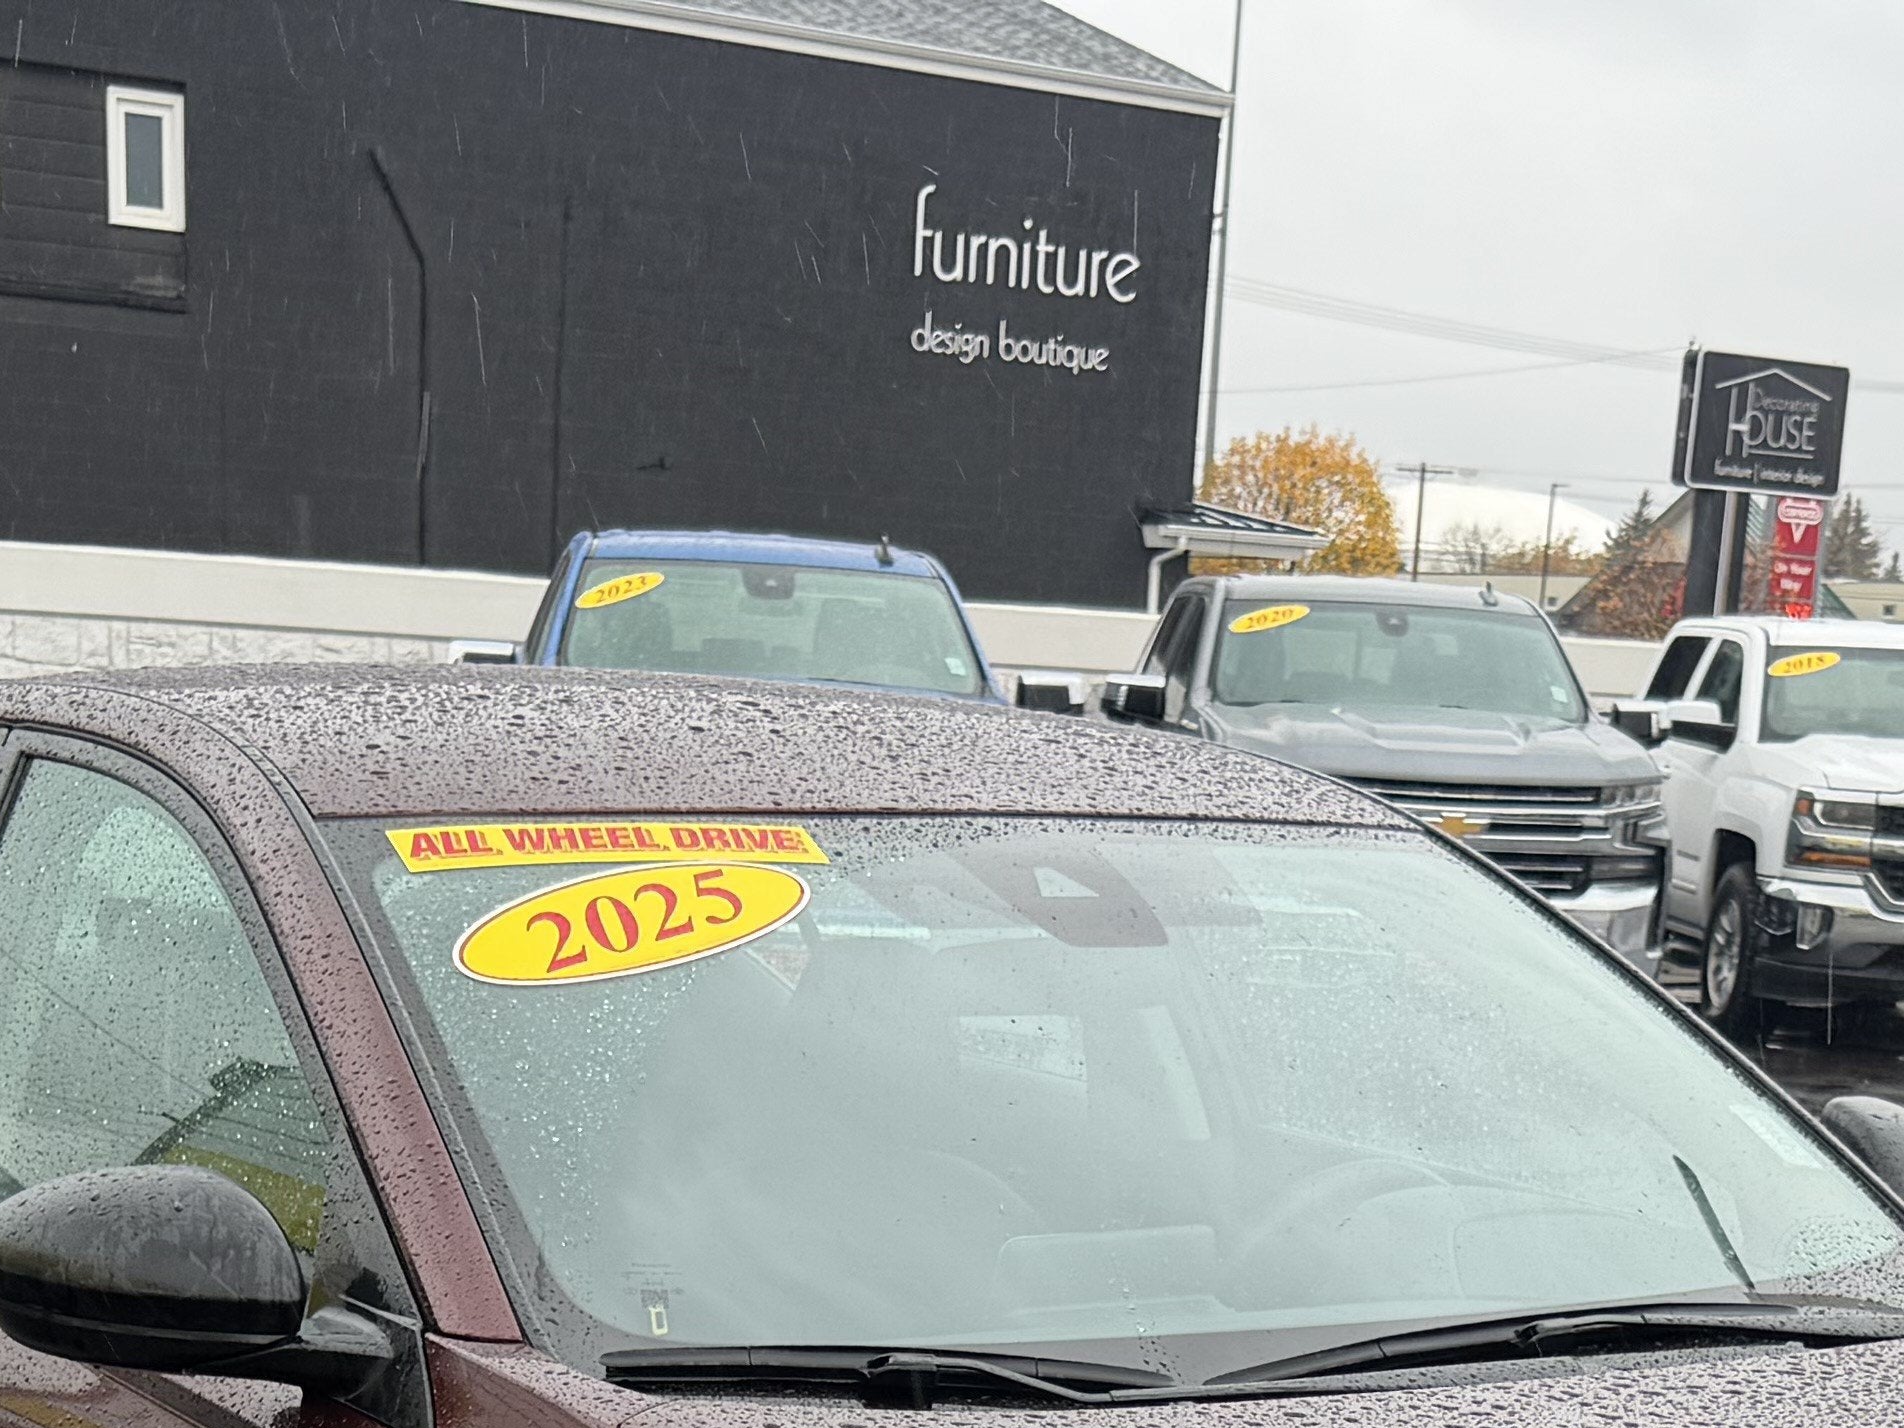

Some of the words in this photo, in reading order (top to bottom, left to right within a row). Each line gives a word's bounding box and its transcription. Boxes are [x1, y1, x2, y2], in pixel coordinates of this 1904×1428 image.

[913, 183, 1141, 303] furniture
[910, 309, 990, 364] design
[998, 319, 1110, 375] boutique
[1724, 382, 1818, 458] HOUSE
[596, 575, 648, 604] 2023
[1247, 608, 1294, 629] 2020
[409, 833, 502, 858] ALL
[503, 827, 669, 853] WHEEL
[675, 827, 808, 853] DRIVE
[525, 869, 744, 974] 2025
